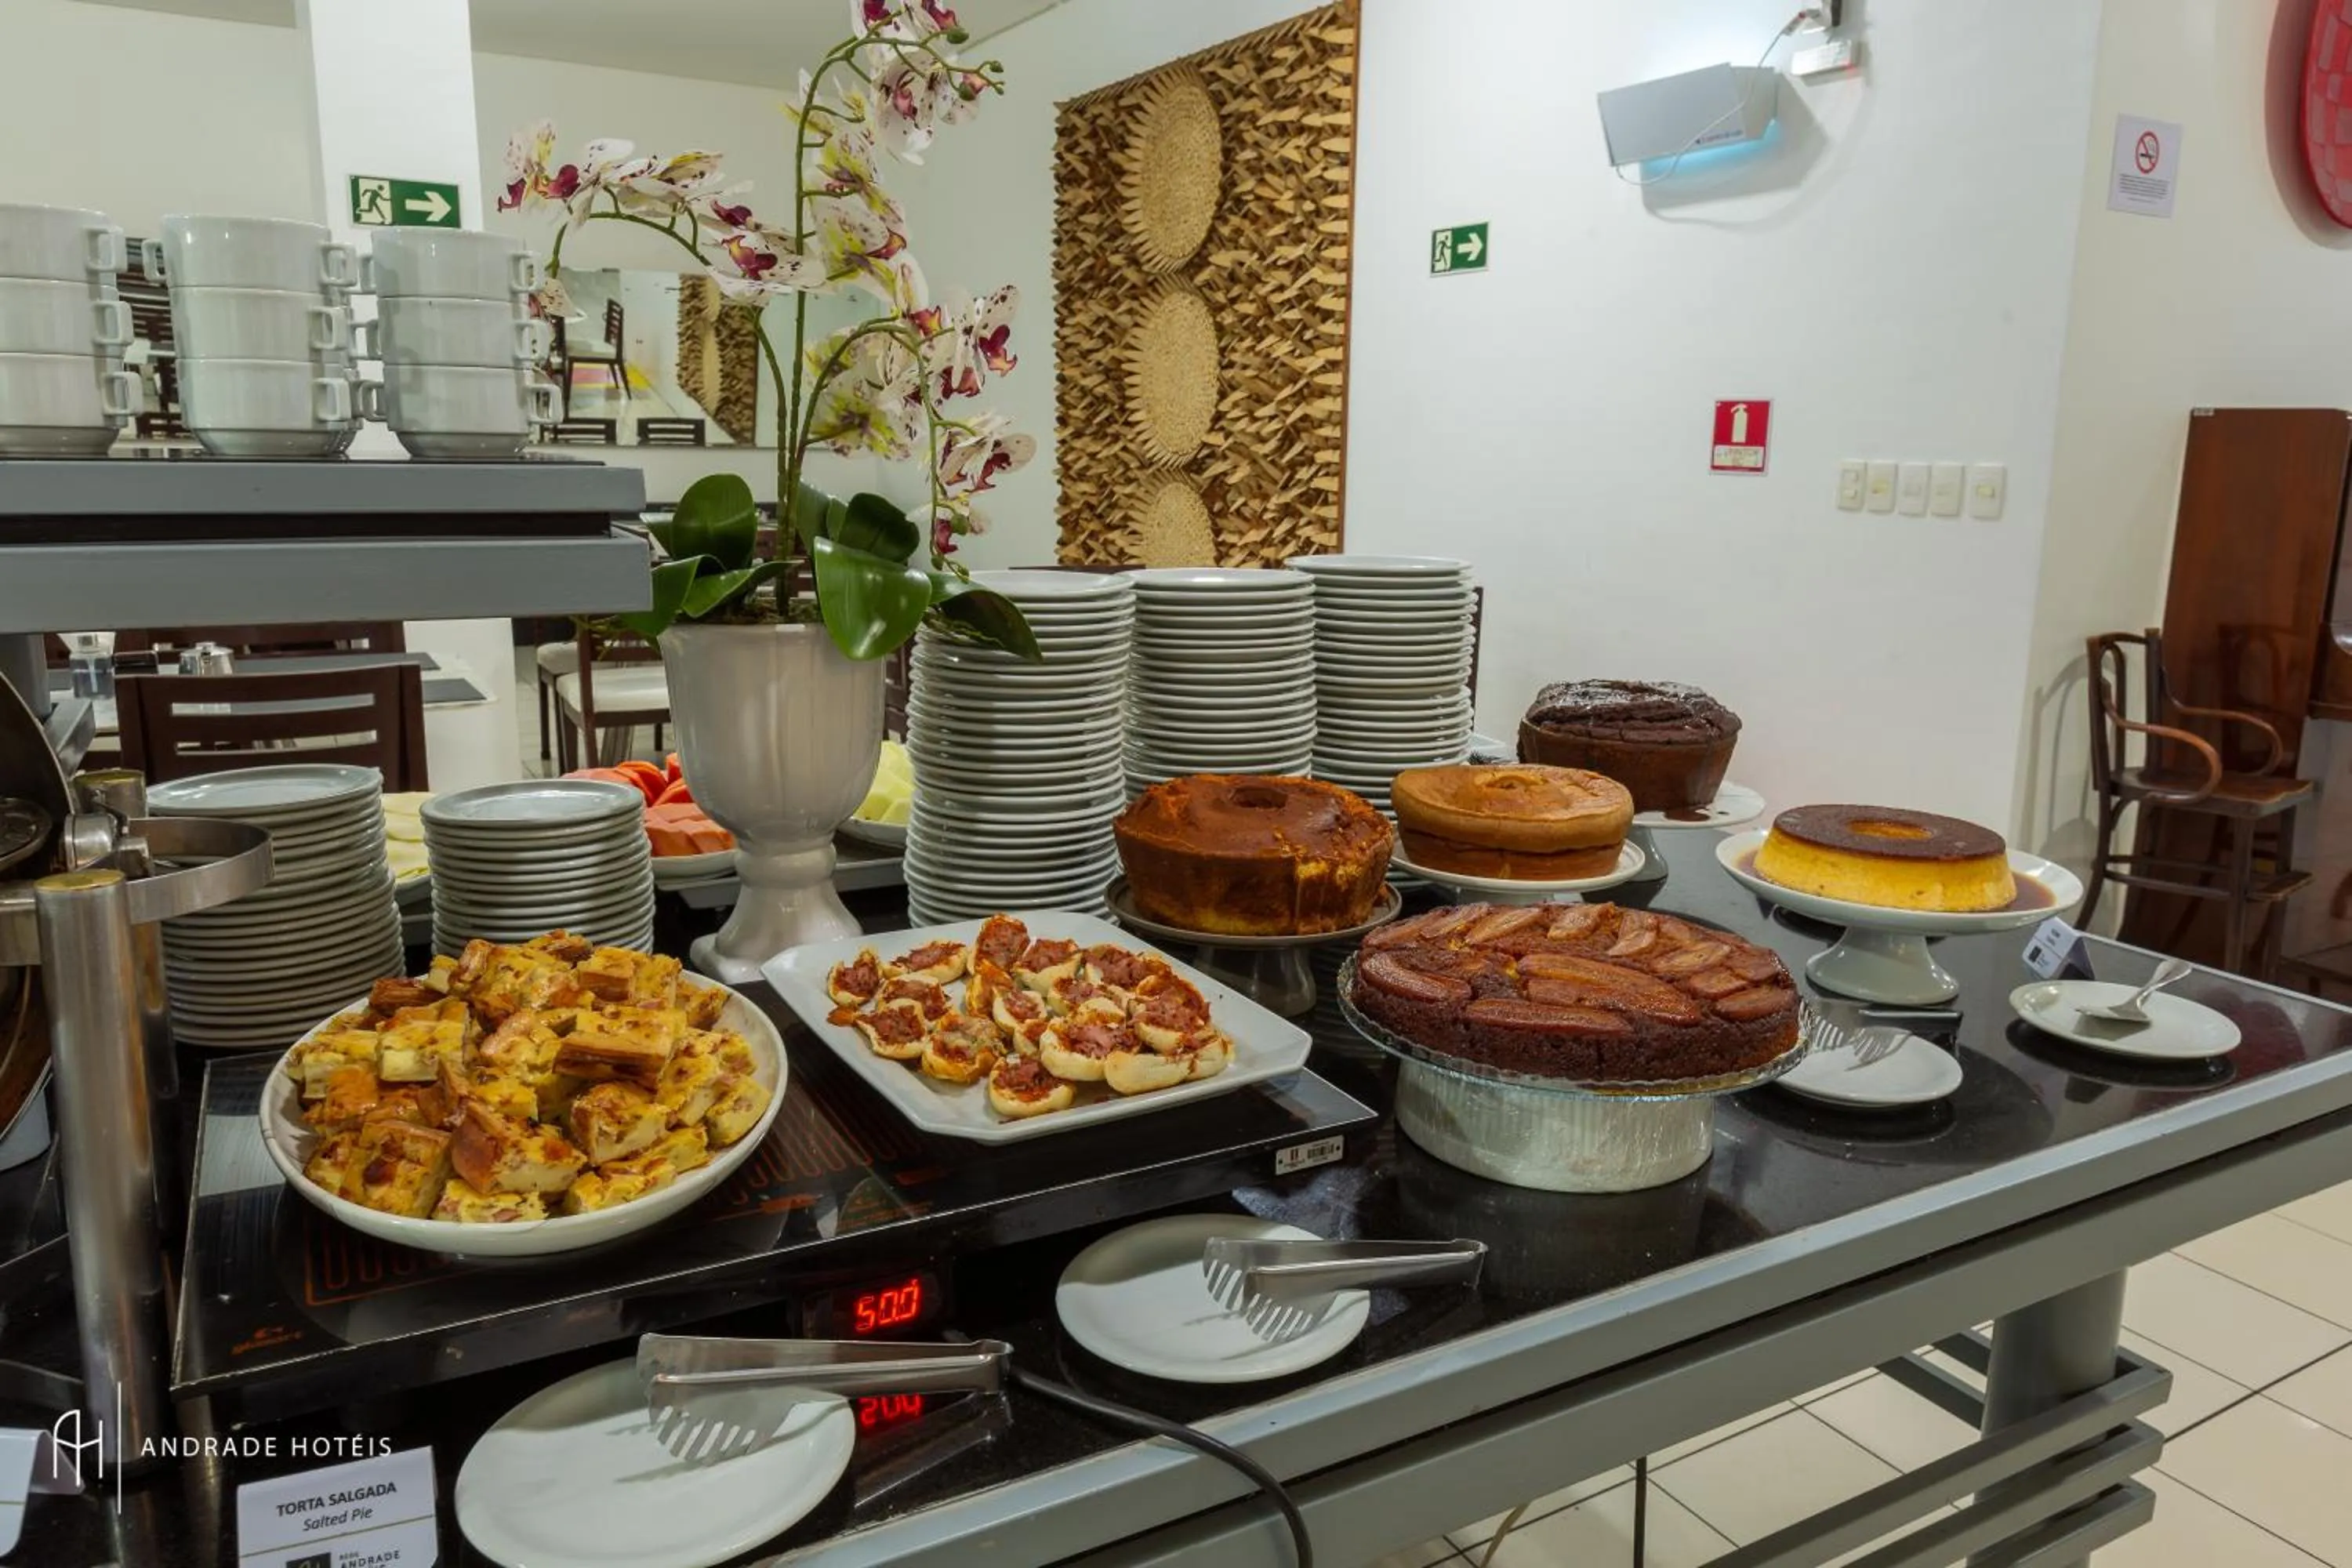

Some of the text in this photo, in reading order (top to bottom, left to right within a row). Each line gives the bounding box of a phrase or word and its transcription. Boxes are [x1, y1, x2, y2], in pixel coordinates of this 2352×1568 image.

[277, 1482, 397, 1517] TORTA SALGADA
[303, 1507, 374, 1531] Salted Pie
[341, 1550, 400, 1568] ANDRADE
